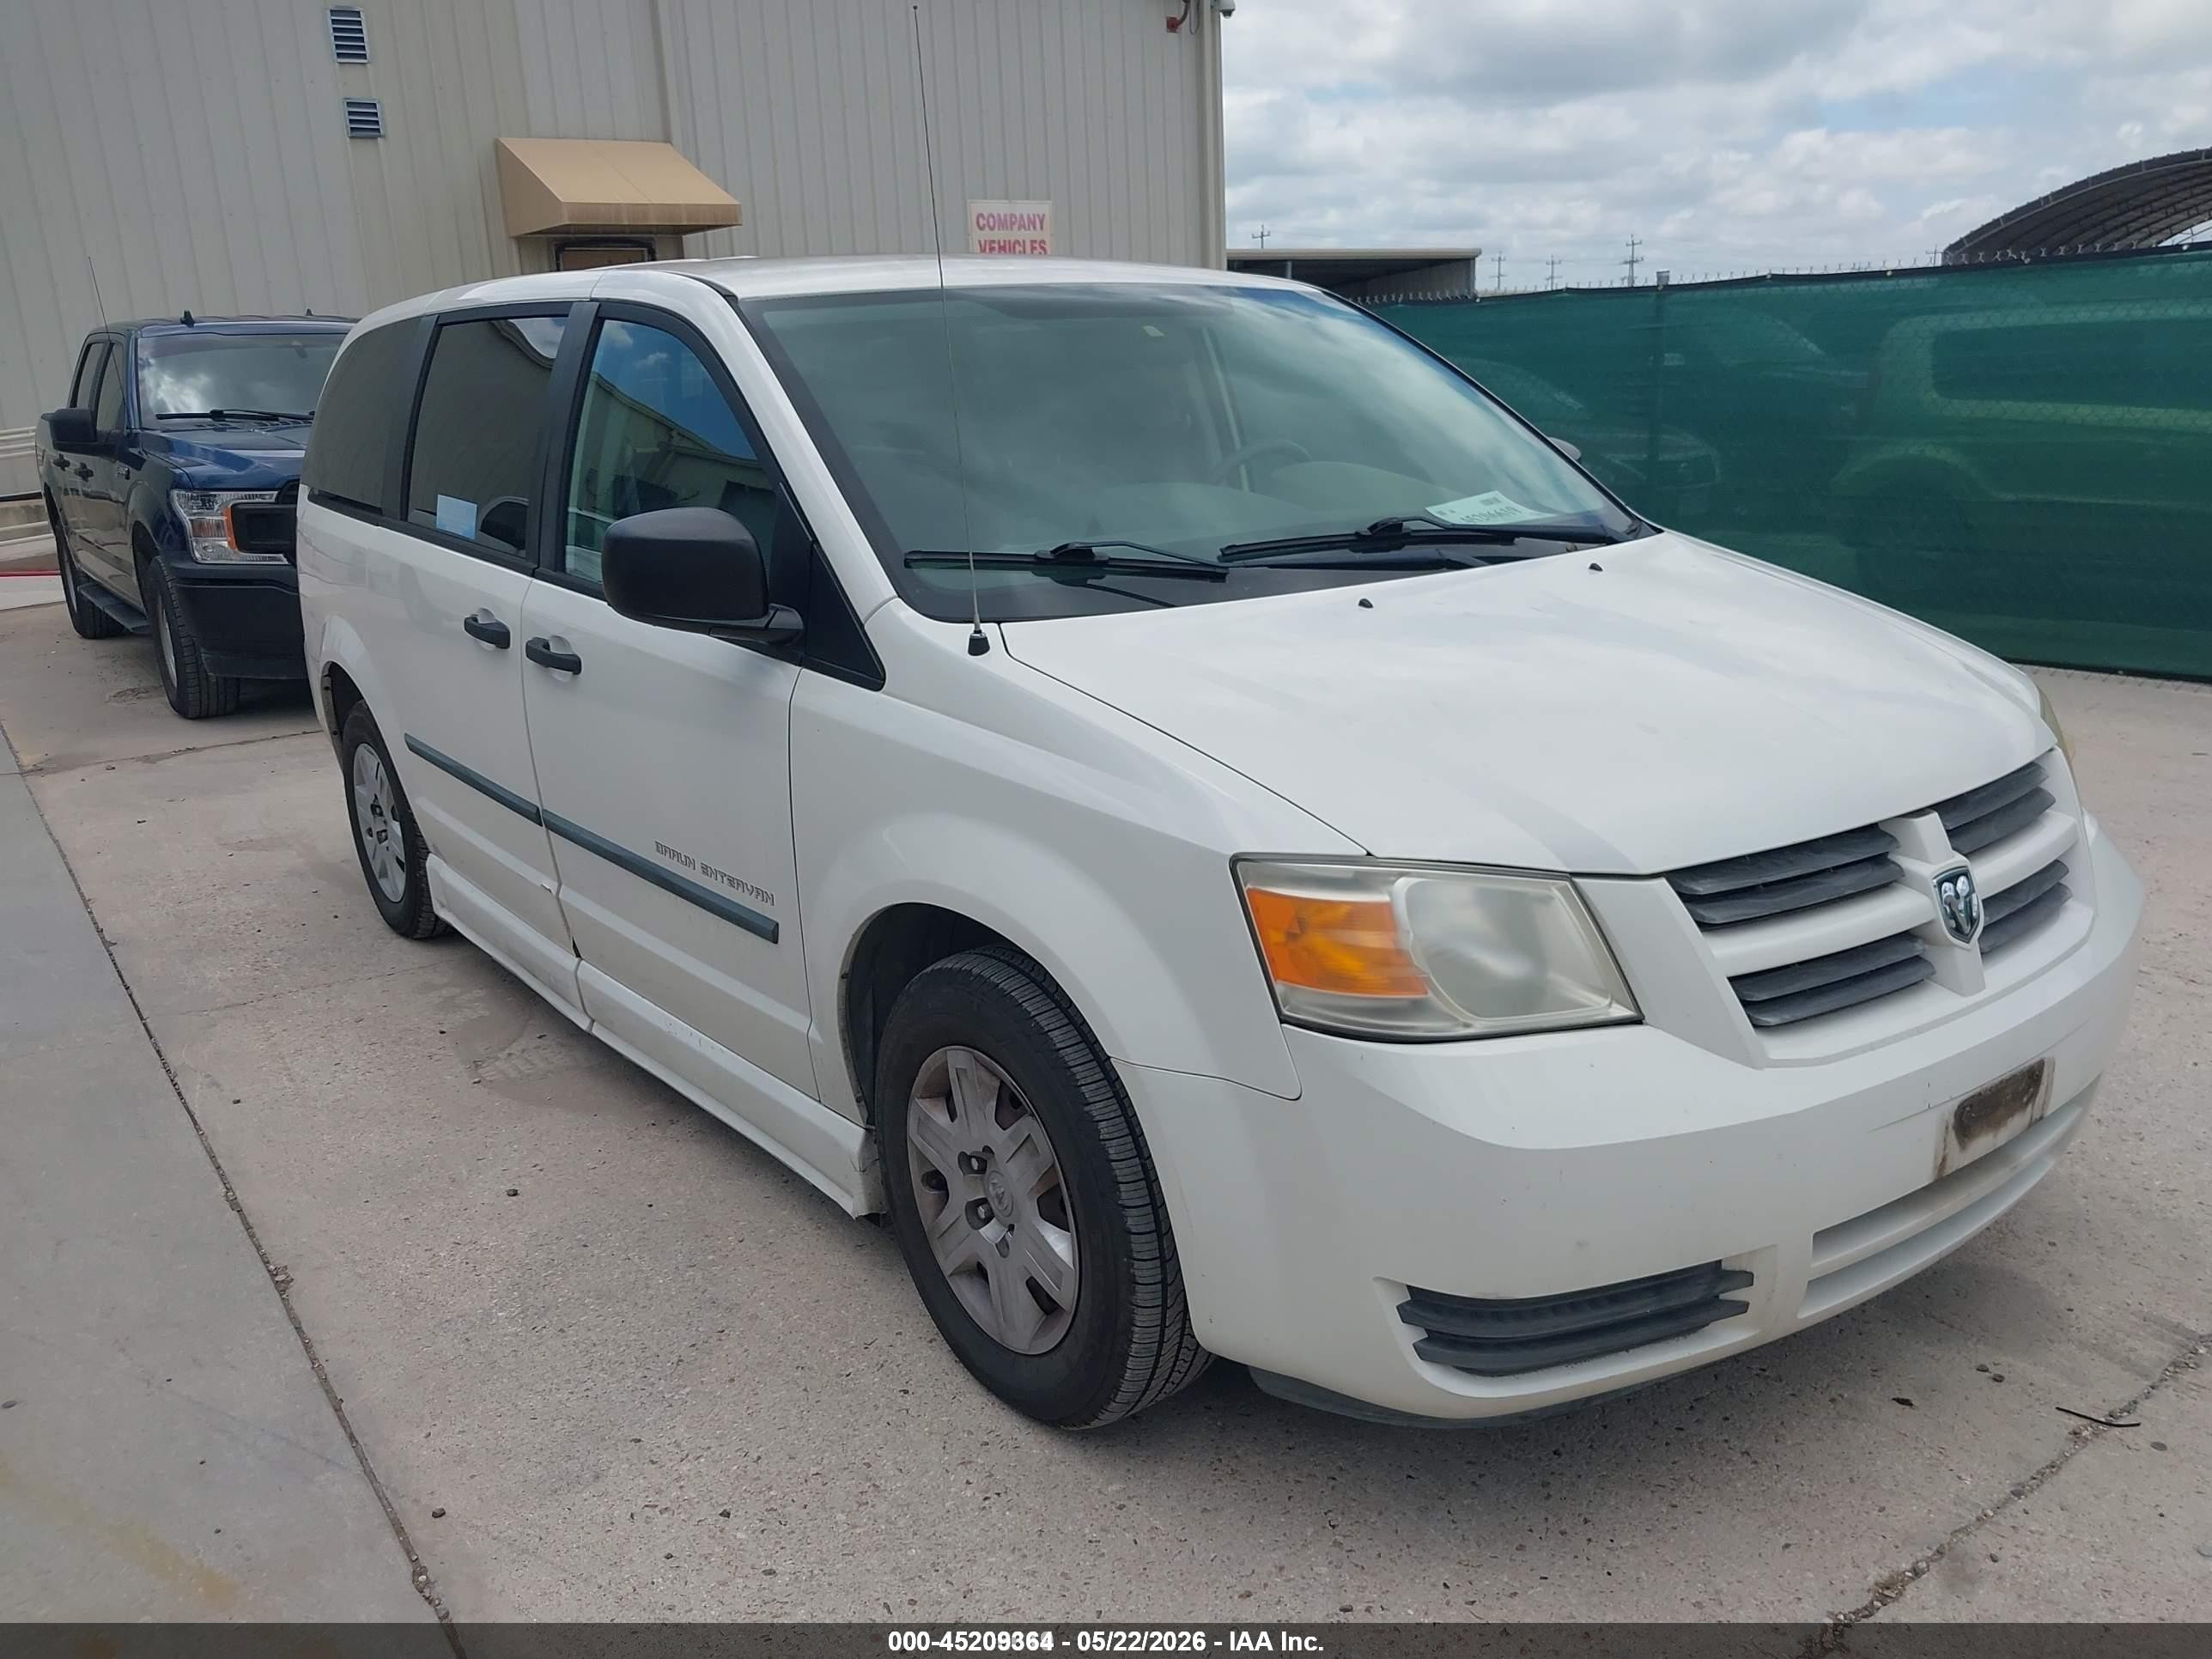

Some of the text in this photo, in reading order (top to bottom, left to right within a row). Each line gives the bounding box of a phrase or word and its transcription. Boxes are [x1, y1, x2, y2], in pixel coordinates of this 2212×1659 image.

[975, 212, 1045, 232] COMPANY
[654, 841, 775, 907] BRAUN ENTERVAN
